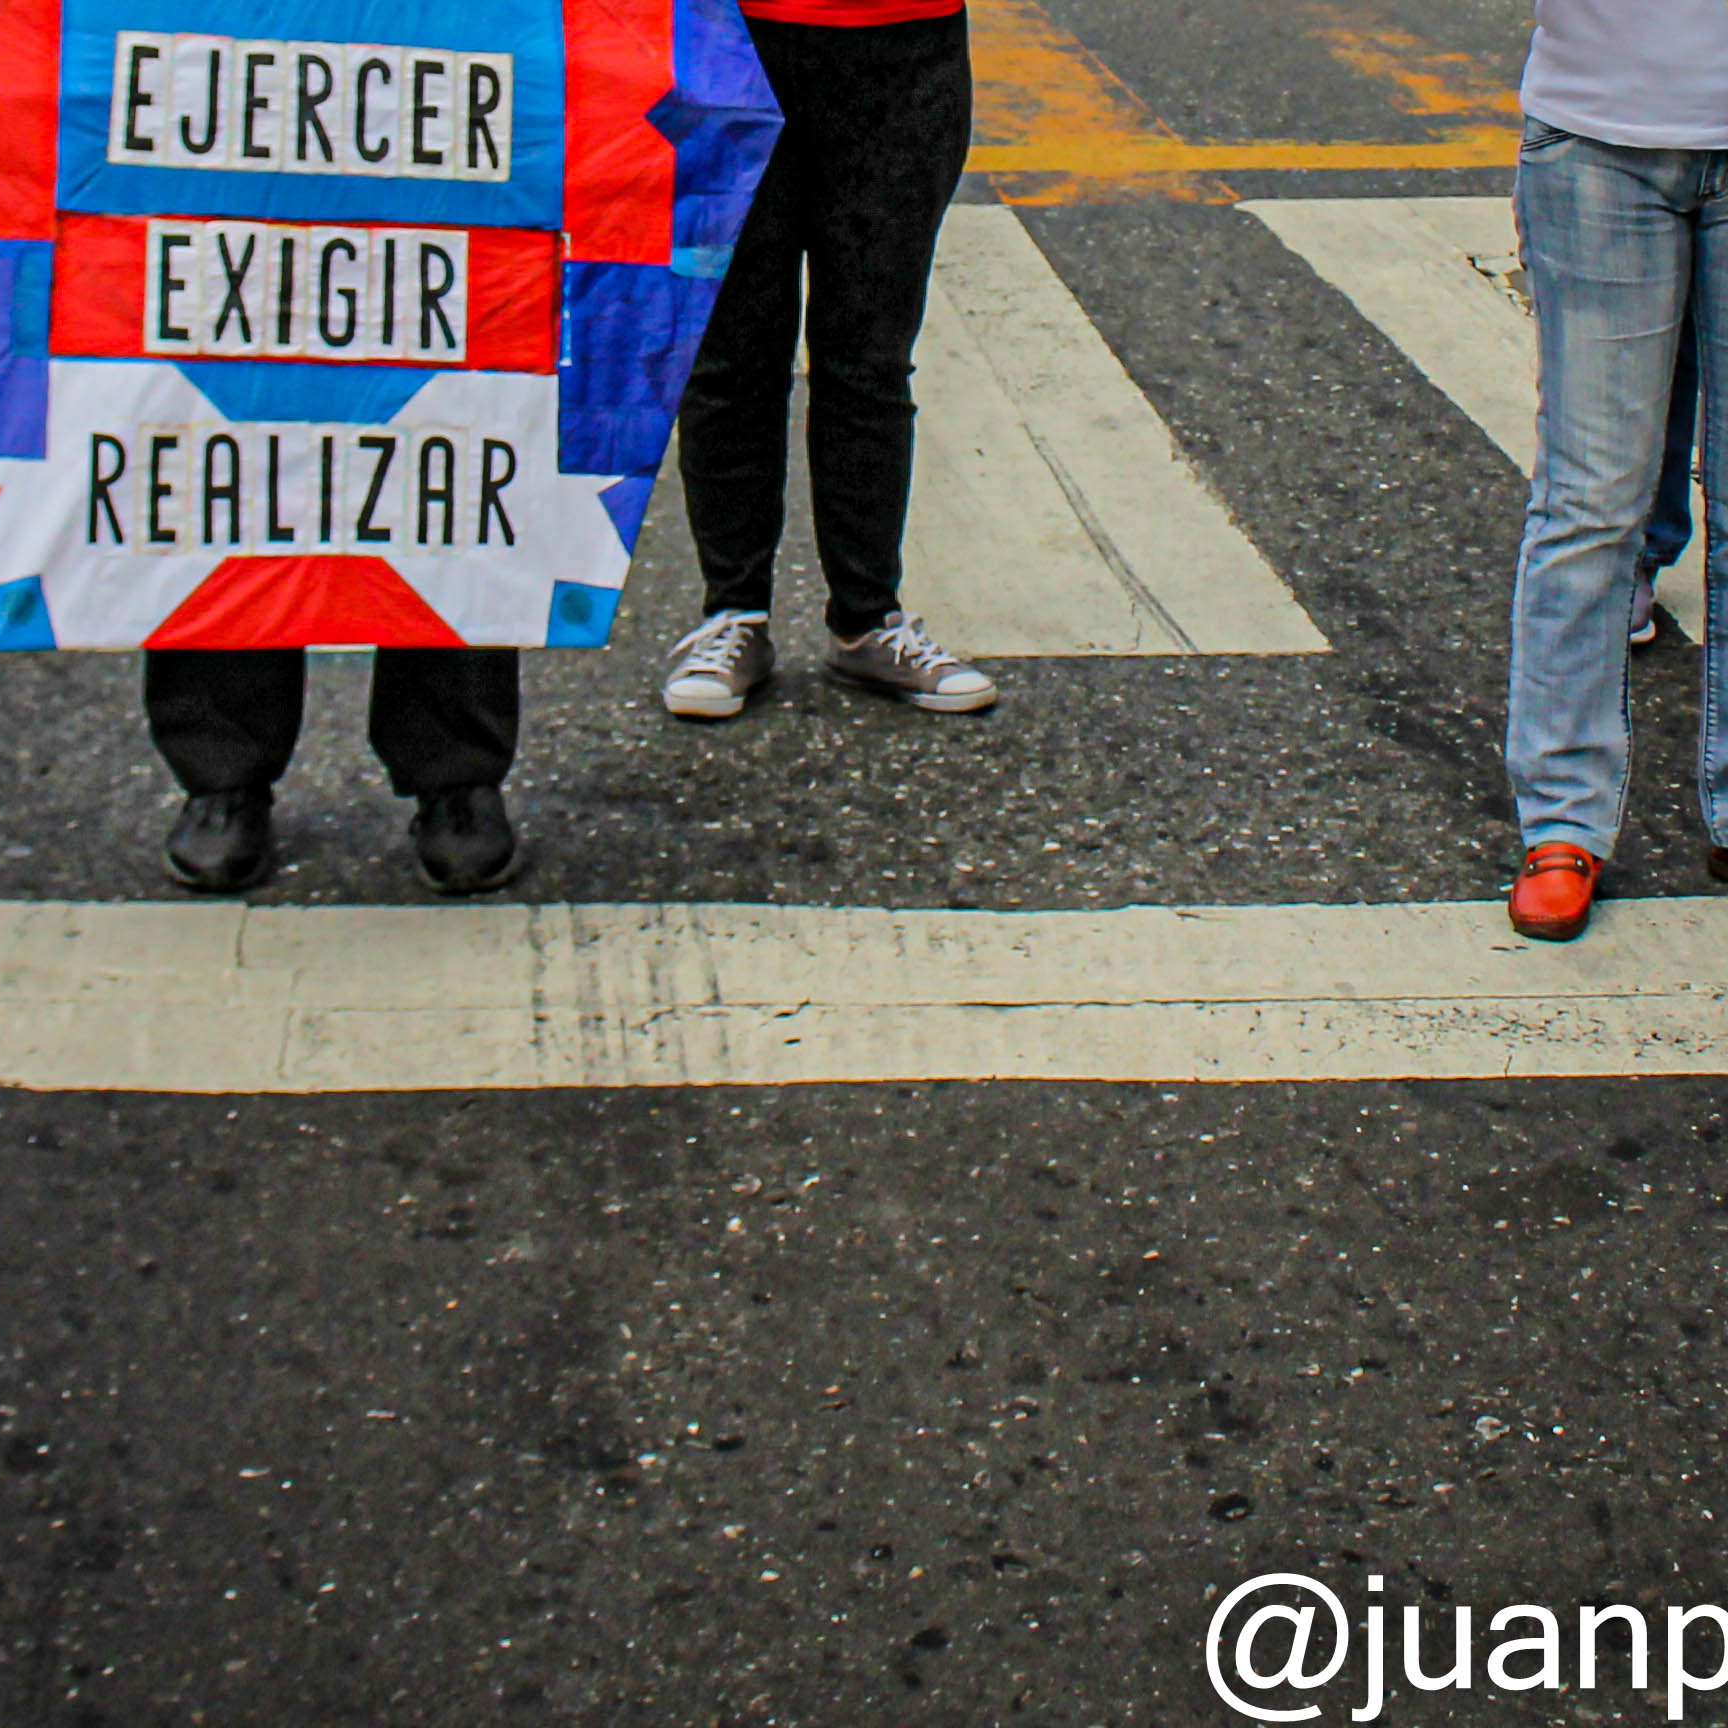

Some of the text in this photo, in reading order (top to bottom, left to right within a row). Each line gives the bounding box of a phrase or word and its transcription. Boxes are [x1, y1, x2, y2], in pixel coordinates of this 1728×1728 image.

[122, 44, 504, 172] EJERCER
[159, 231, 456, 350] EXIGIR
[87, 432, 518, 550] REALIZAR
